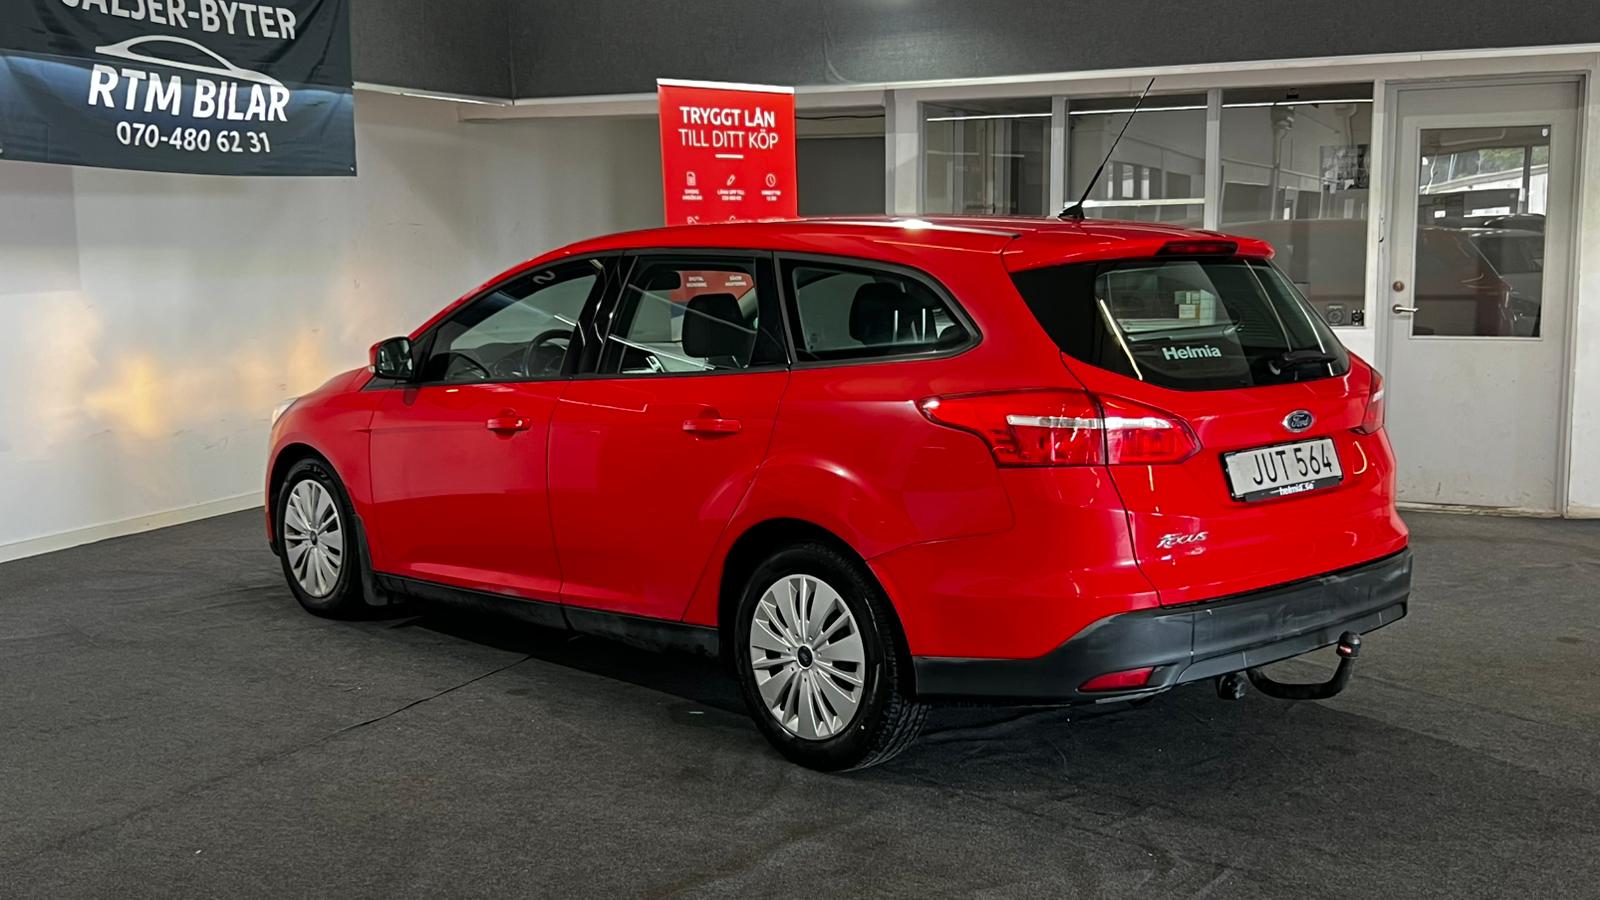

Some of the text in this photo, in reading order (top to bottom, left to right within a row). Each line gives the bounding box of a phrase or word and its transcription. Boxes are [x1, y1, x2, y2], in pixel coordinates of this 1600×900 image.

[62, 0, 297, 40] LJER-BYTER
[88, 63, 290, 122] RTM BILAR
[679, 106, 775, 128] TRYGGT LÅN
[116, 121, 271, 153] 070-480 62 31
[678, 128, 779, 149] TILL DITT KÖP
[1161, 344, 1222, 361] Helmia
[1285, 413, 1311, 429] Ford
[1253, 444, 1333, 485] JUT 564
